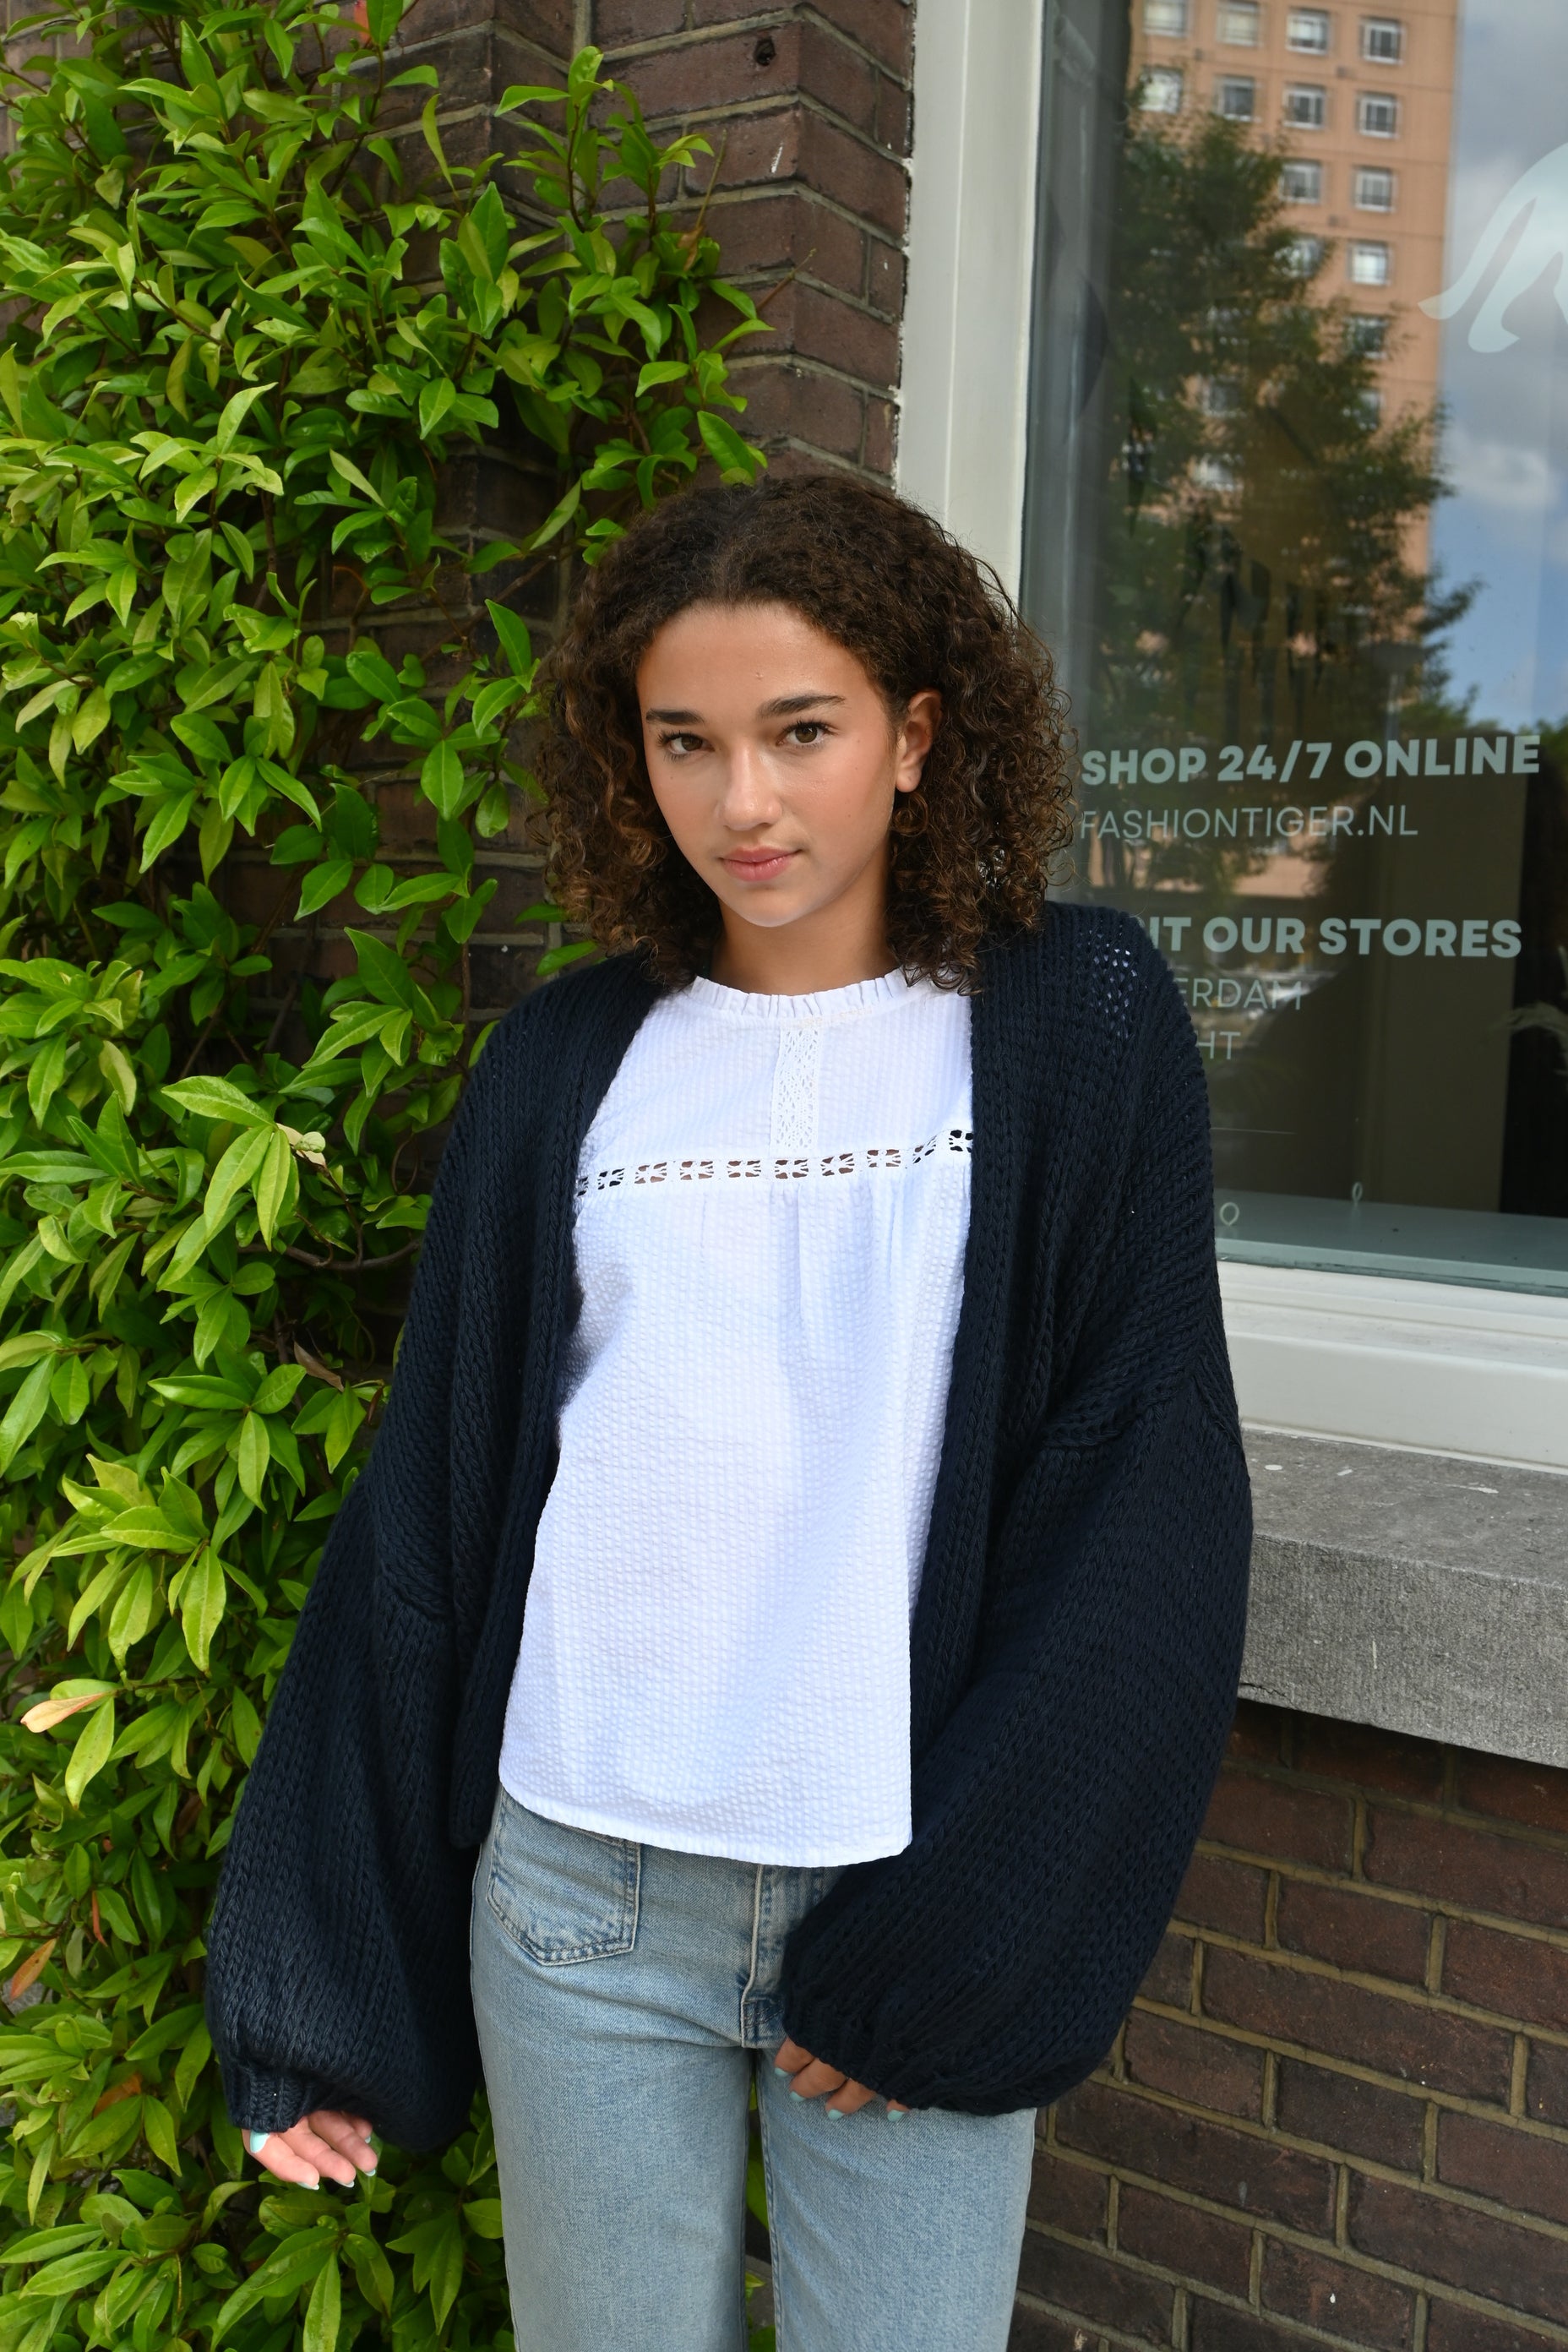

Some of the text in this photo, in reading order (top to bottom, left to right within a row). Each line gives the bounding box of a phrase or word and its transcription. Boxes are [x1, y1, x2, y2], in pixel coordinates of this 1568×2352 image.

[1081, 735, 1541, 786] SHOP 24/7 ONLINE
[1081, 805, 1418, 839] FASHIONTIGER.NL
[1135, 916, 1522, 958] IT OUR STORES
